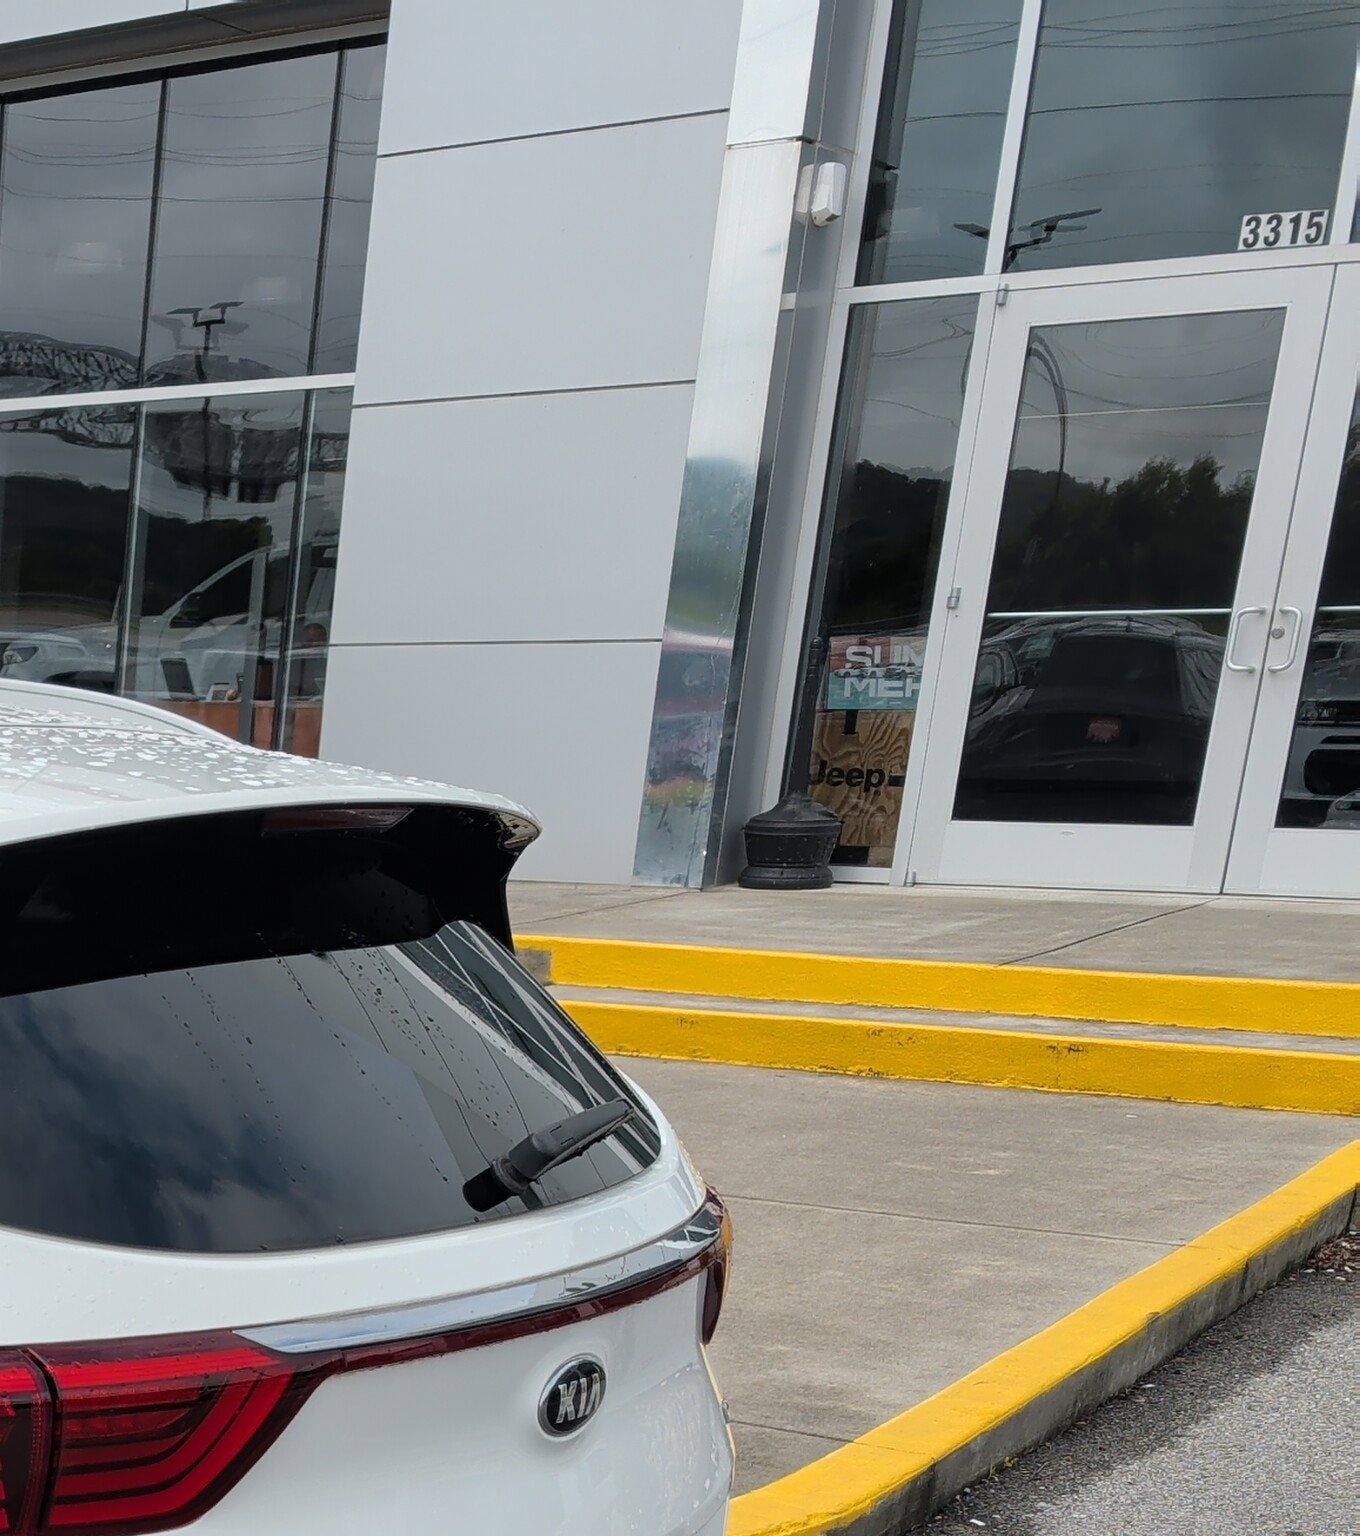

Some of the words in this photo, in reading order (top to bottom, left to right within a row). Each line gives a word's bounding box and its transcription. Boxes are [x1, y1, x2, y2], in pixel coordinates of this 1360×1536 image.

[1242, 211, 1325, 249] 3315
[809, 759, 886, 792] Jeep
[555, 1373, 601, 1424] KIA
